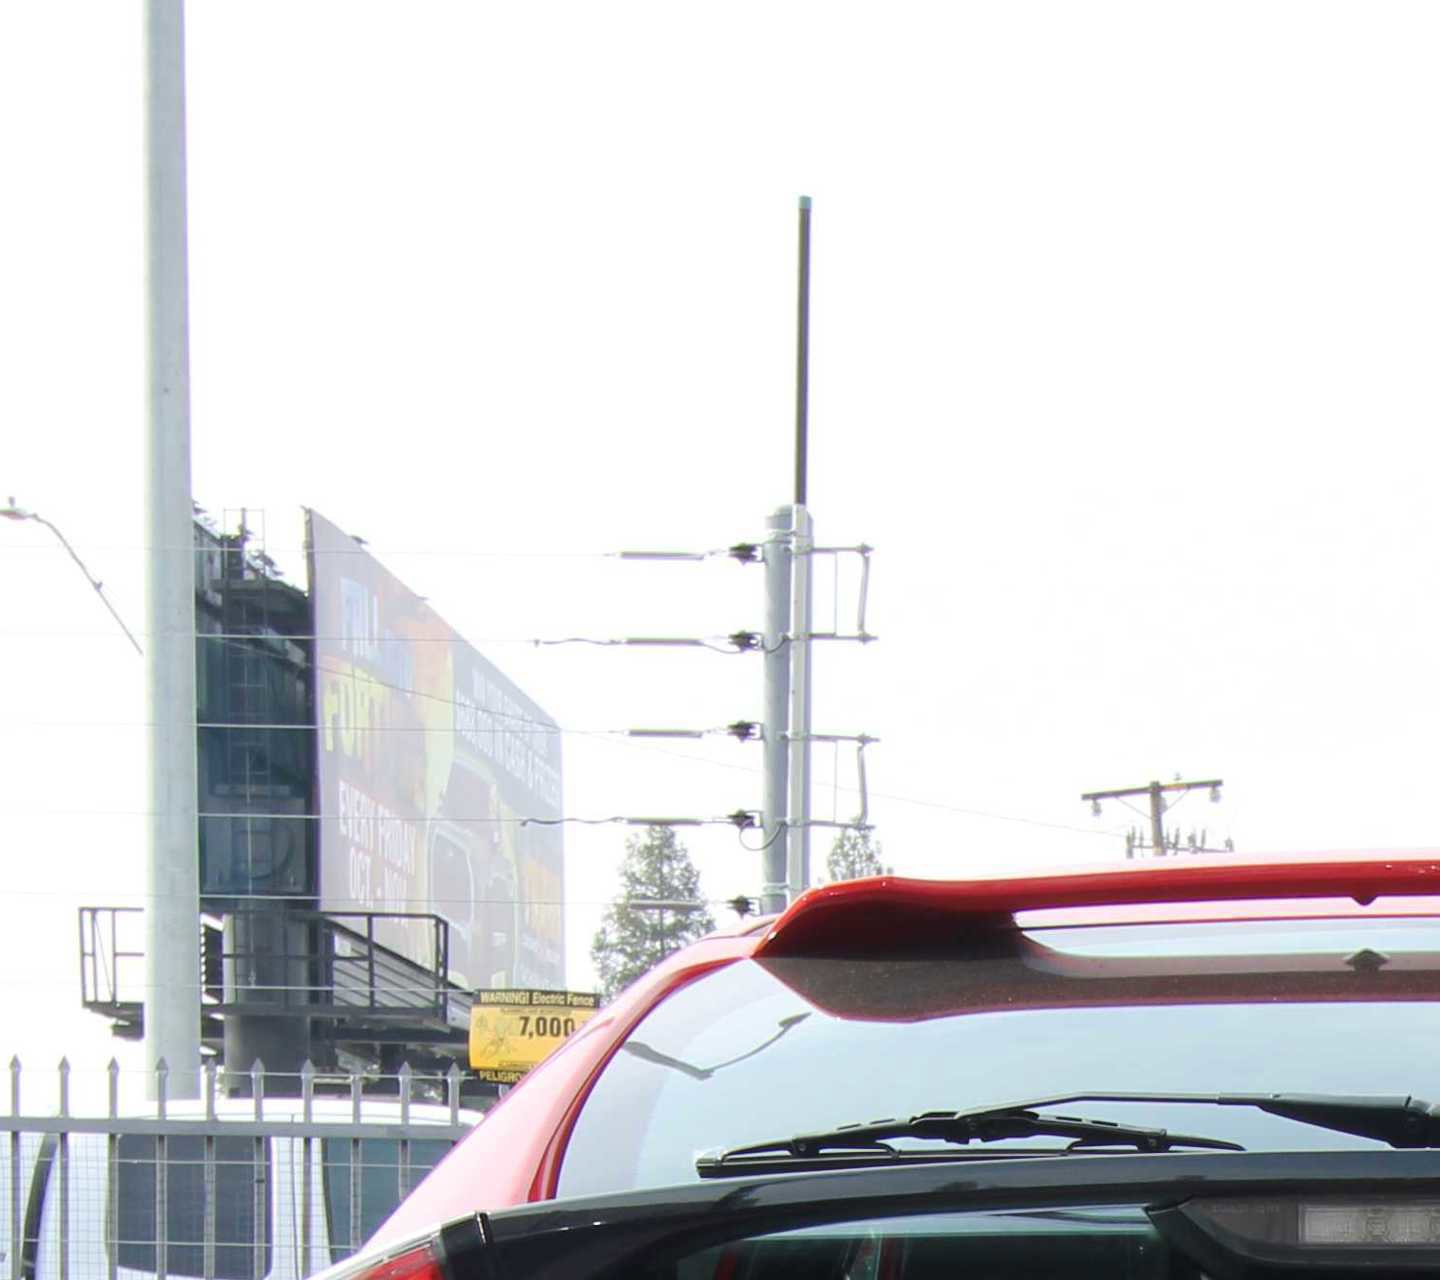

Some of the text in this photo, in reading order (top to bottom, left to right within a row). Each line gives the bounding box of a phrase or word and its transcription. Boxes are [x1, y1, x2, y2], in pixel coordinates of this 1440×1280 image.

[339, 780, 375, 852] EVERY
[480, 991, 595, 1008] WARNING! Electric Fence
[519, 1016, 576, 1039] 7,000
